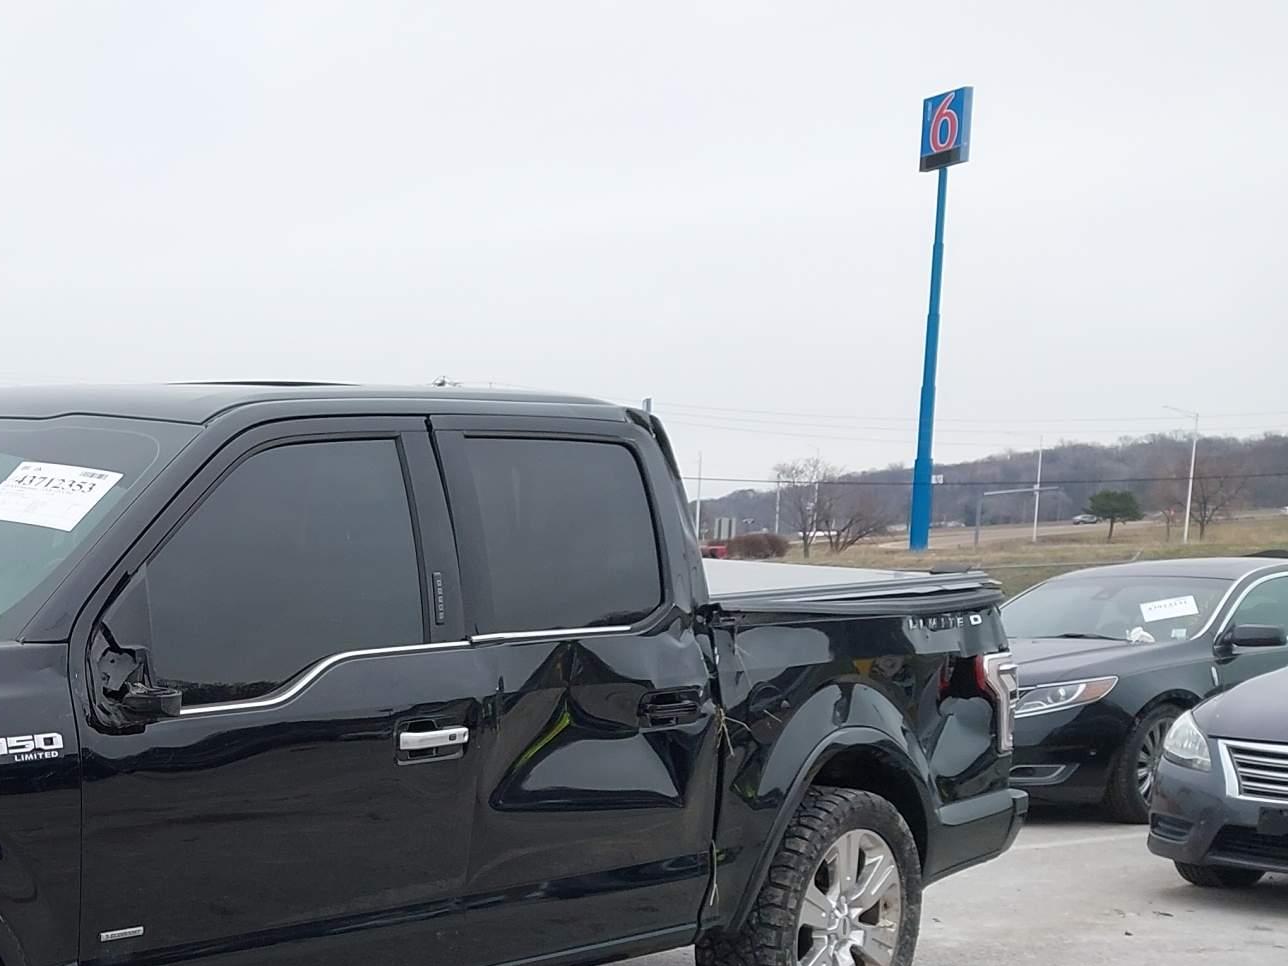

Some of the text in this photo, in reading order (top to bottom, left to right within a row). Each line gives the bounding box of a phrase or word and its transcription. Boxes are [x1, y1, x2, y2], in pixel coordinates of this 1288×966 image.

[929, 91, 959, 154] 6
[15, 475, 96, 494] 43712353
[908, 614, 983, 630] LIMITED
[15, 751, 59, 762] LIMITED
